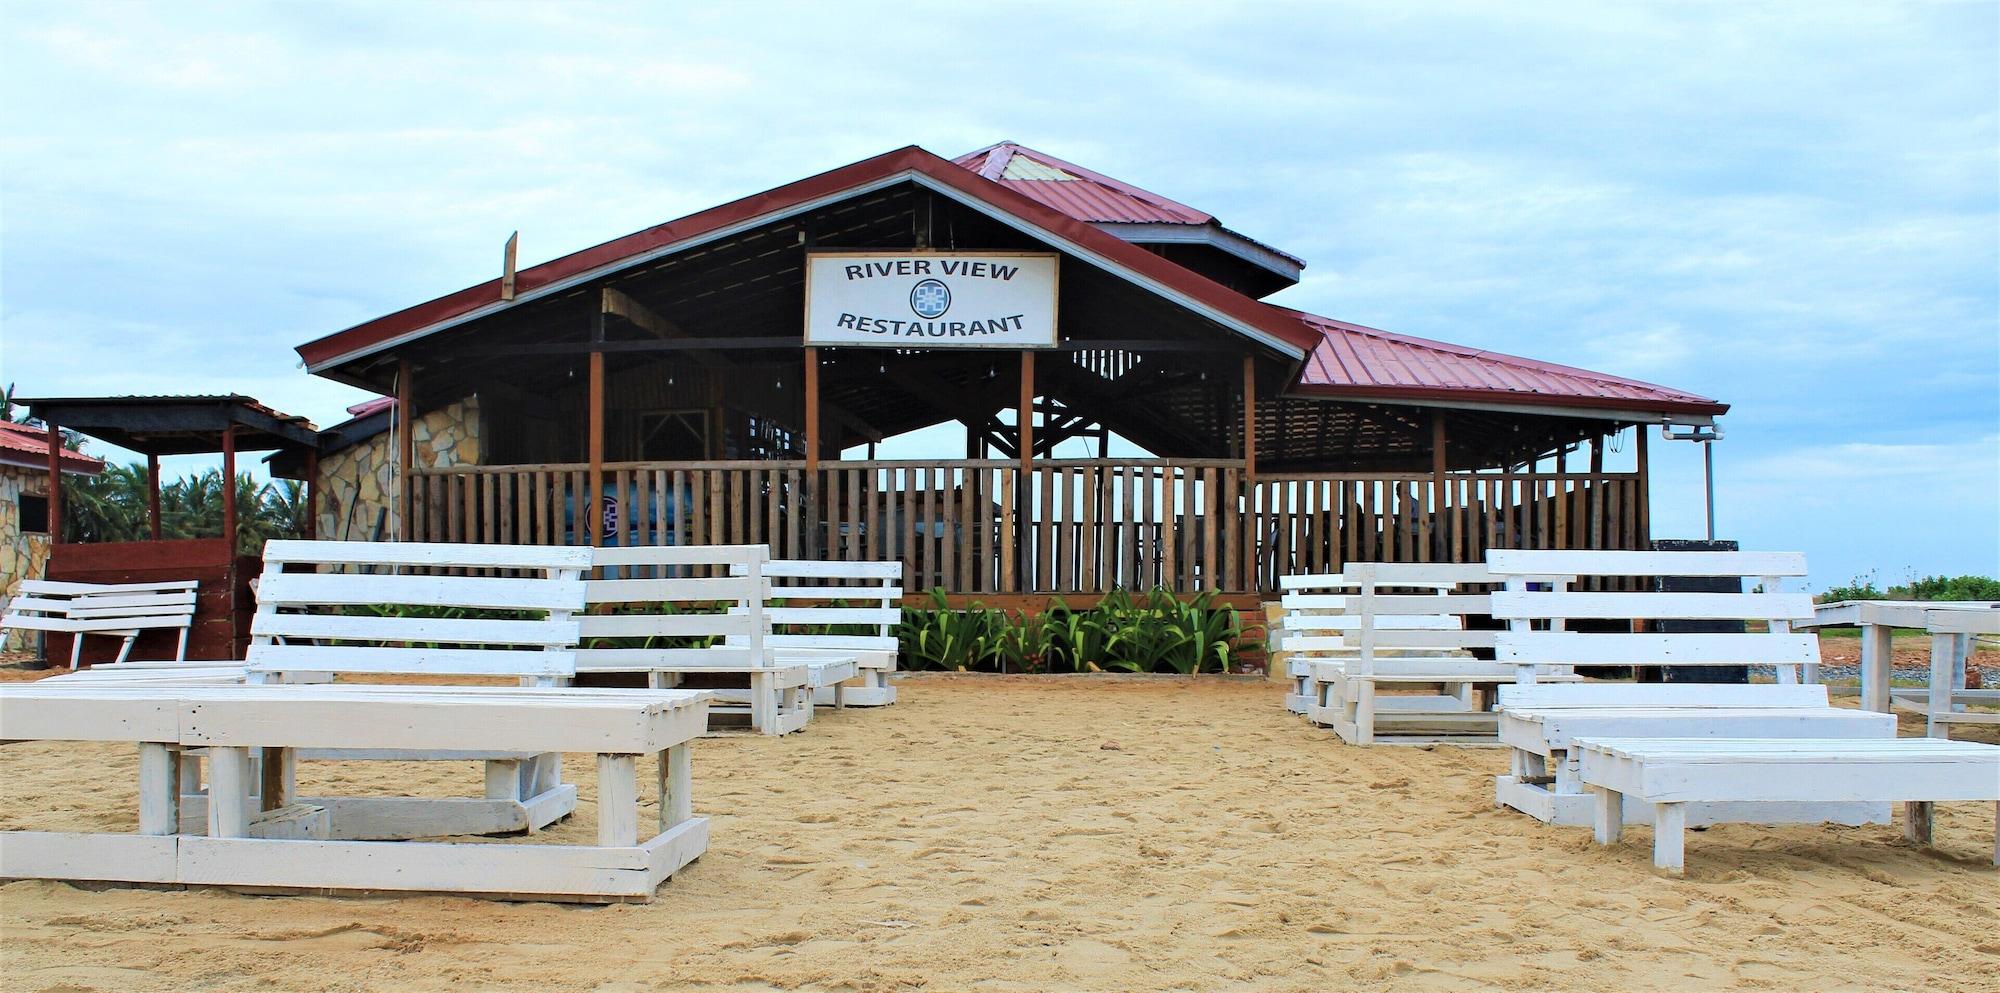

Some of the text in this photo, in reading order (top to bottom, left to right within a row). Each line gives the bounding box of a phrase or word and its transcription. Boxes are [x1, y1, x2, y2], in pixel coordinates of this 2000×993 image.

[845, 260, 1019, 281] RIVER VIEW
[836, 312, 1025, 337] RESTAURANT
